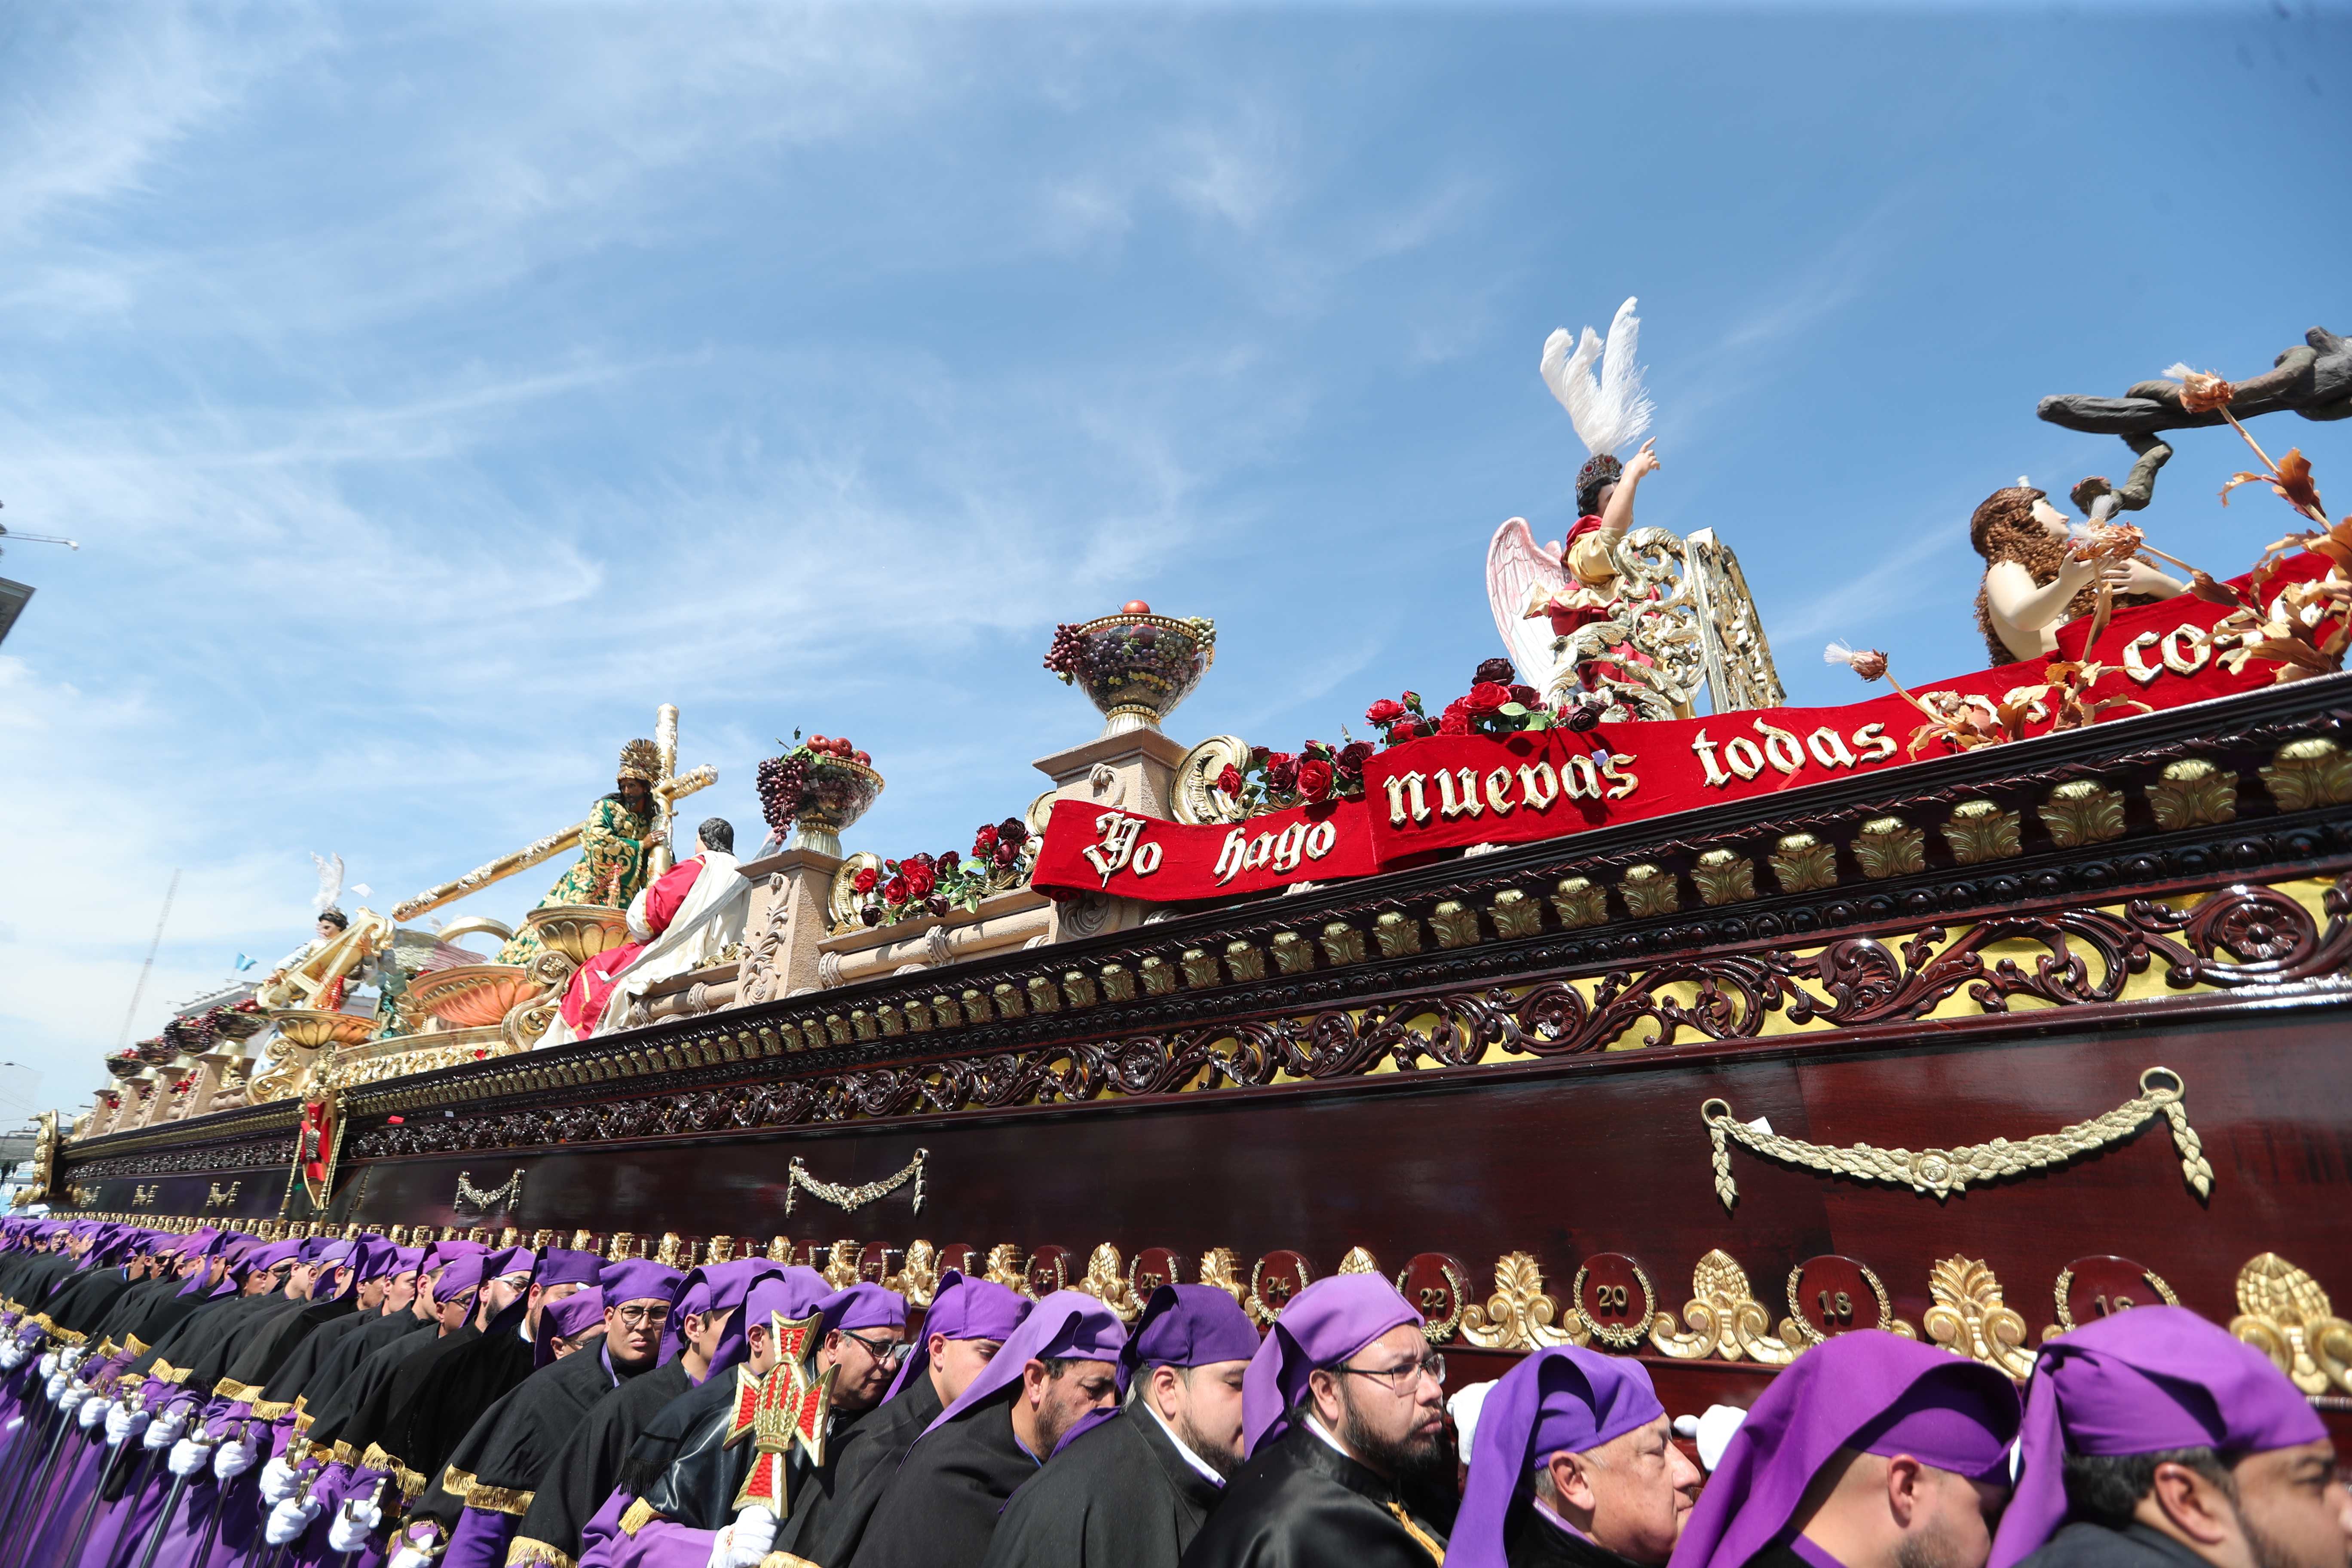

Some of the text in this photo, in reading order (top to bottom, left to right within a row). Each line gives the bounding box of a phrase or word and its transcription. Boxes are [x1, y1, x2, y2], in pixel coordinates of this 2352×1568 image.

[1082, 811, 1164, 888] Yo
[1213, 820, 1337, 887] hago
[1383, 753, 1638, 825] nuevas
[1691, 717, 1898, 787] todas
[1266, 1276, 1291, 1296] 24
[1597, 1285, 1629, 1307] 20
[1420, 1287, 1447, 1308] 22
[1818, 1290, 1853, 1317] 18
